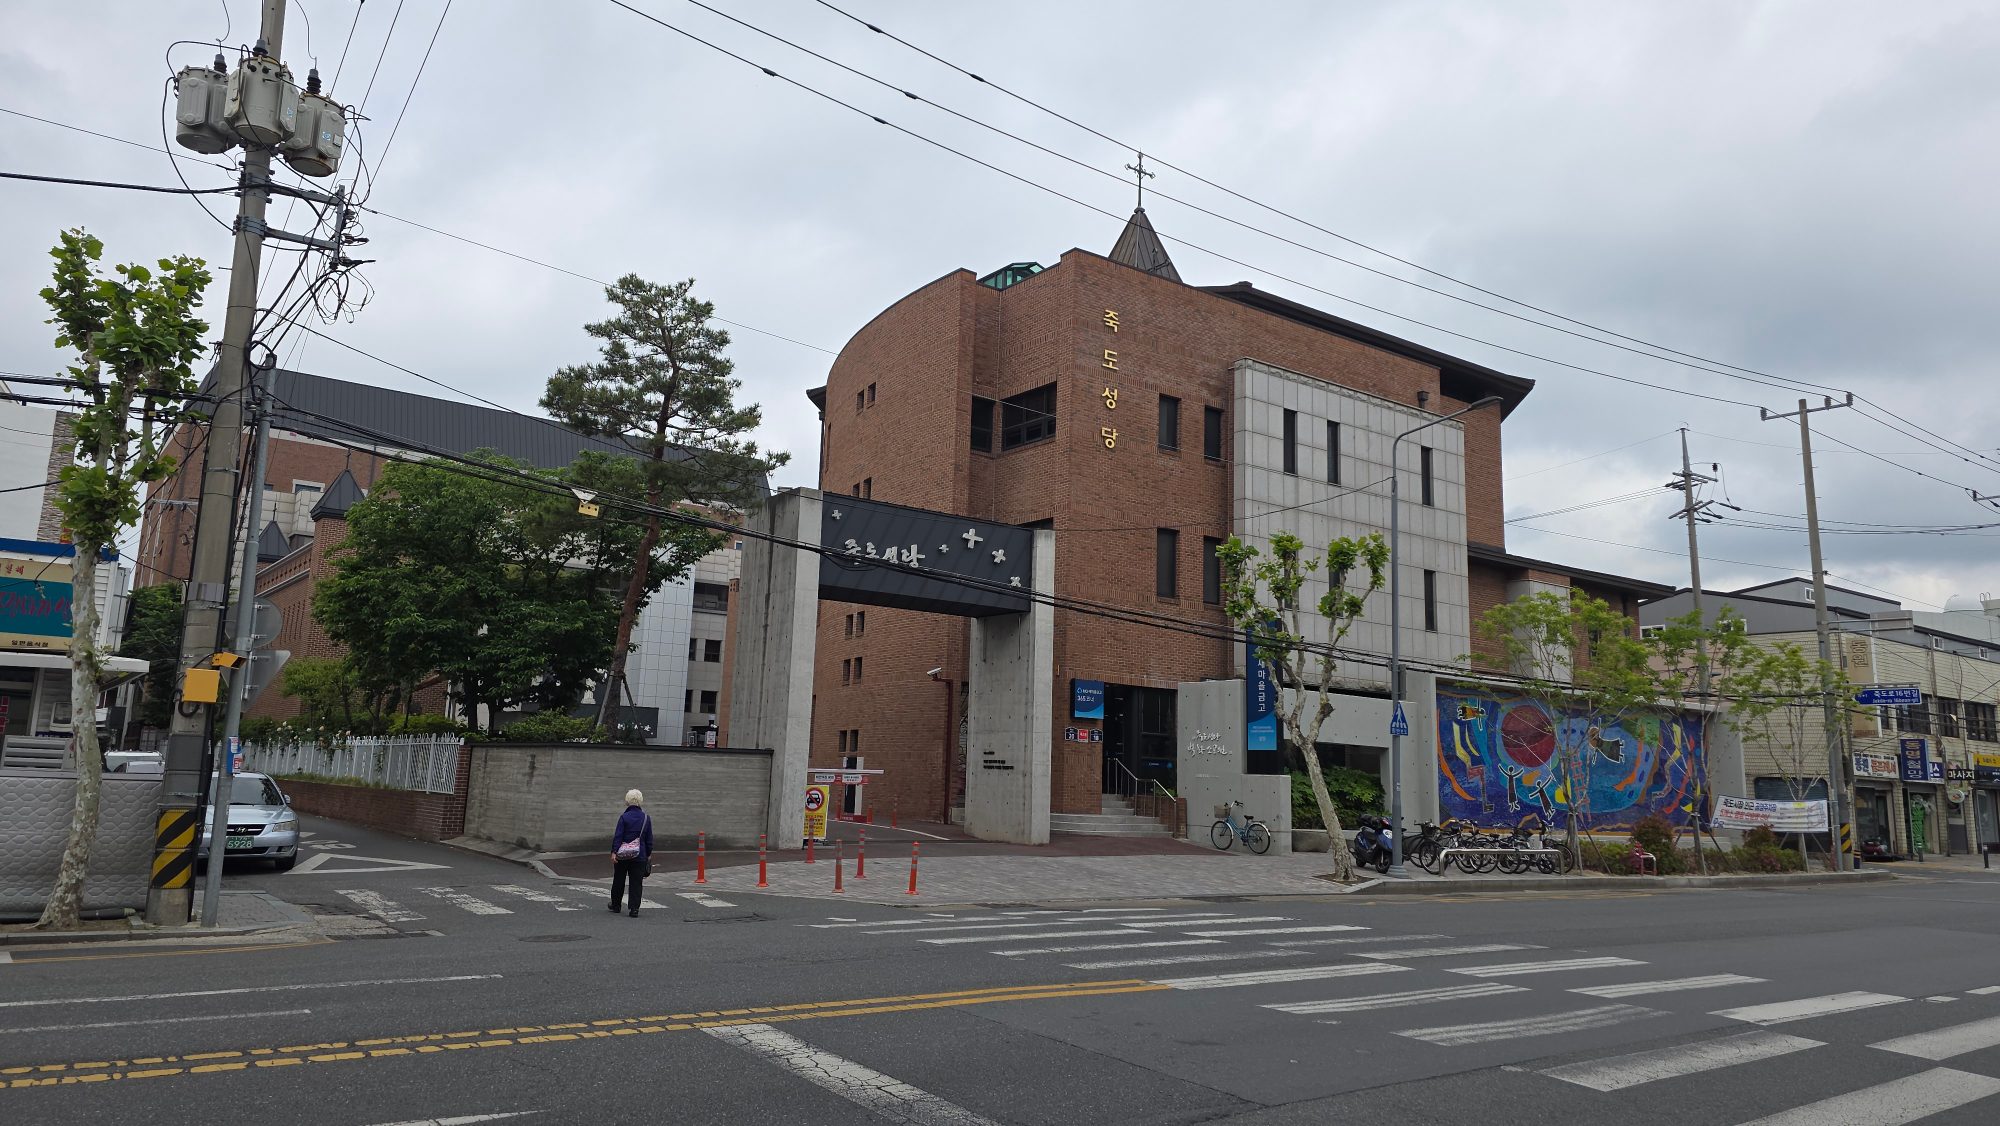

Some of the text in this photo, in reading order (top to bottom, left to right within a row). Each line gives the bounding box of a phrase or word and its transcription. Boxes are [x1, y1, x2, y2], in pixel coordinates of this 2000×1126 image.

[1101, 309, 1121, 449] 죽도성당
[1873, 689, 1918, 698] 죽도로16번길
[1948, 769, 1975, 780] 마사지
[228, 840, 252, 849] 5928
